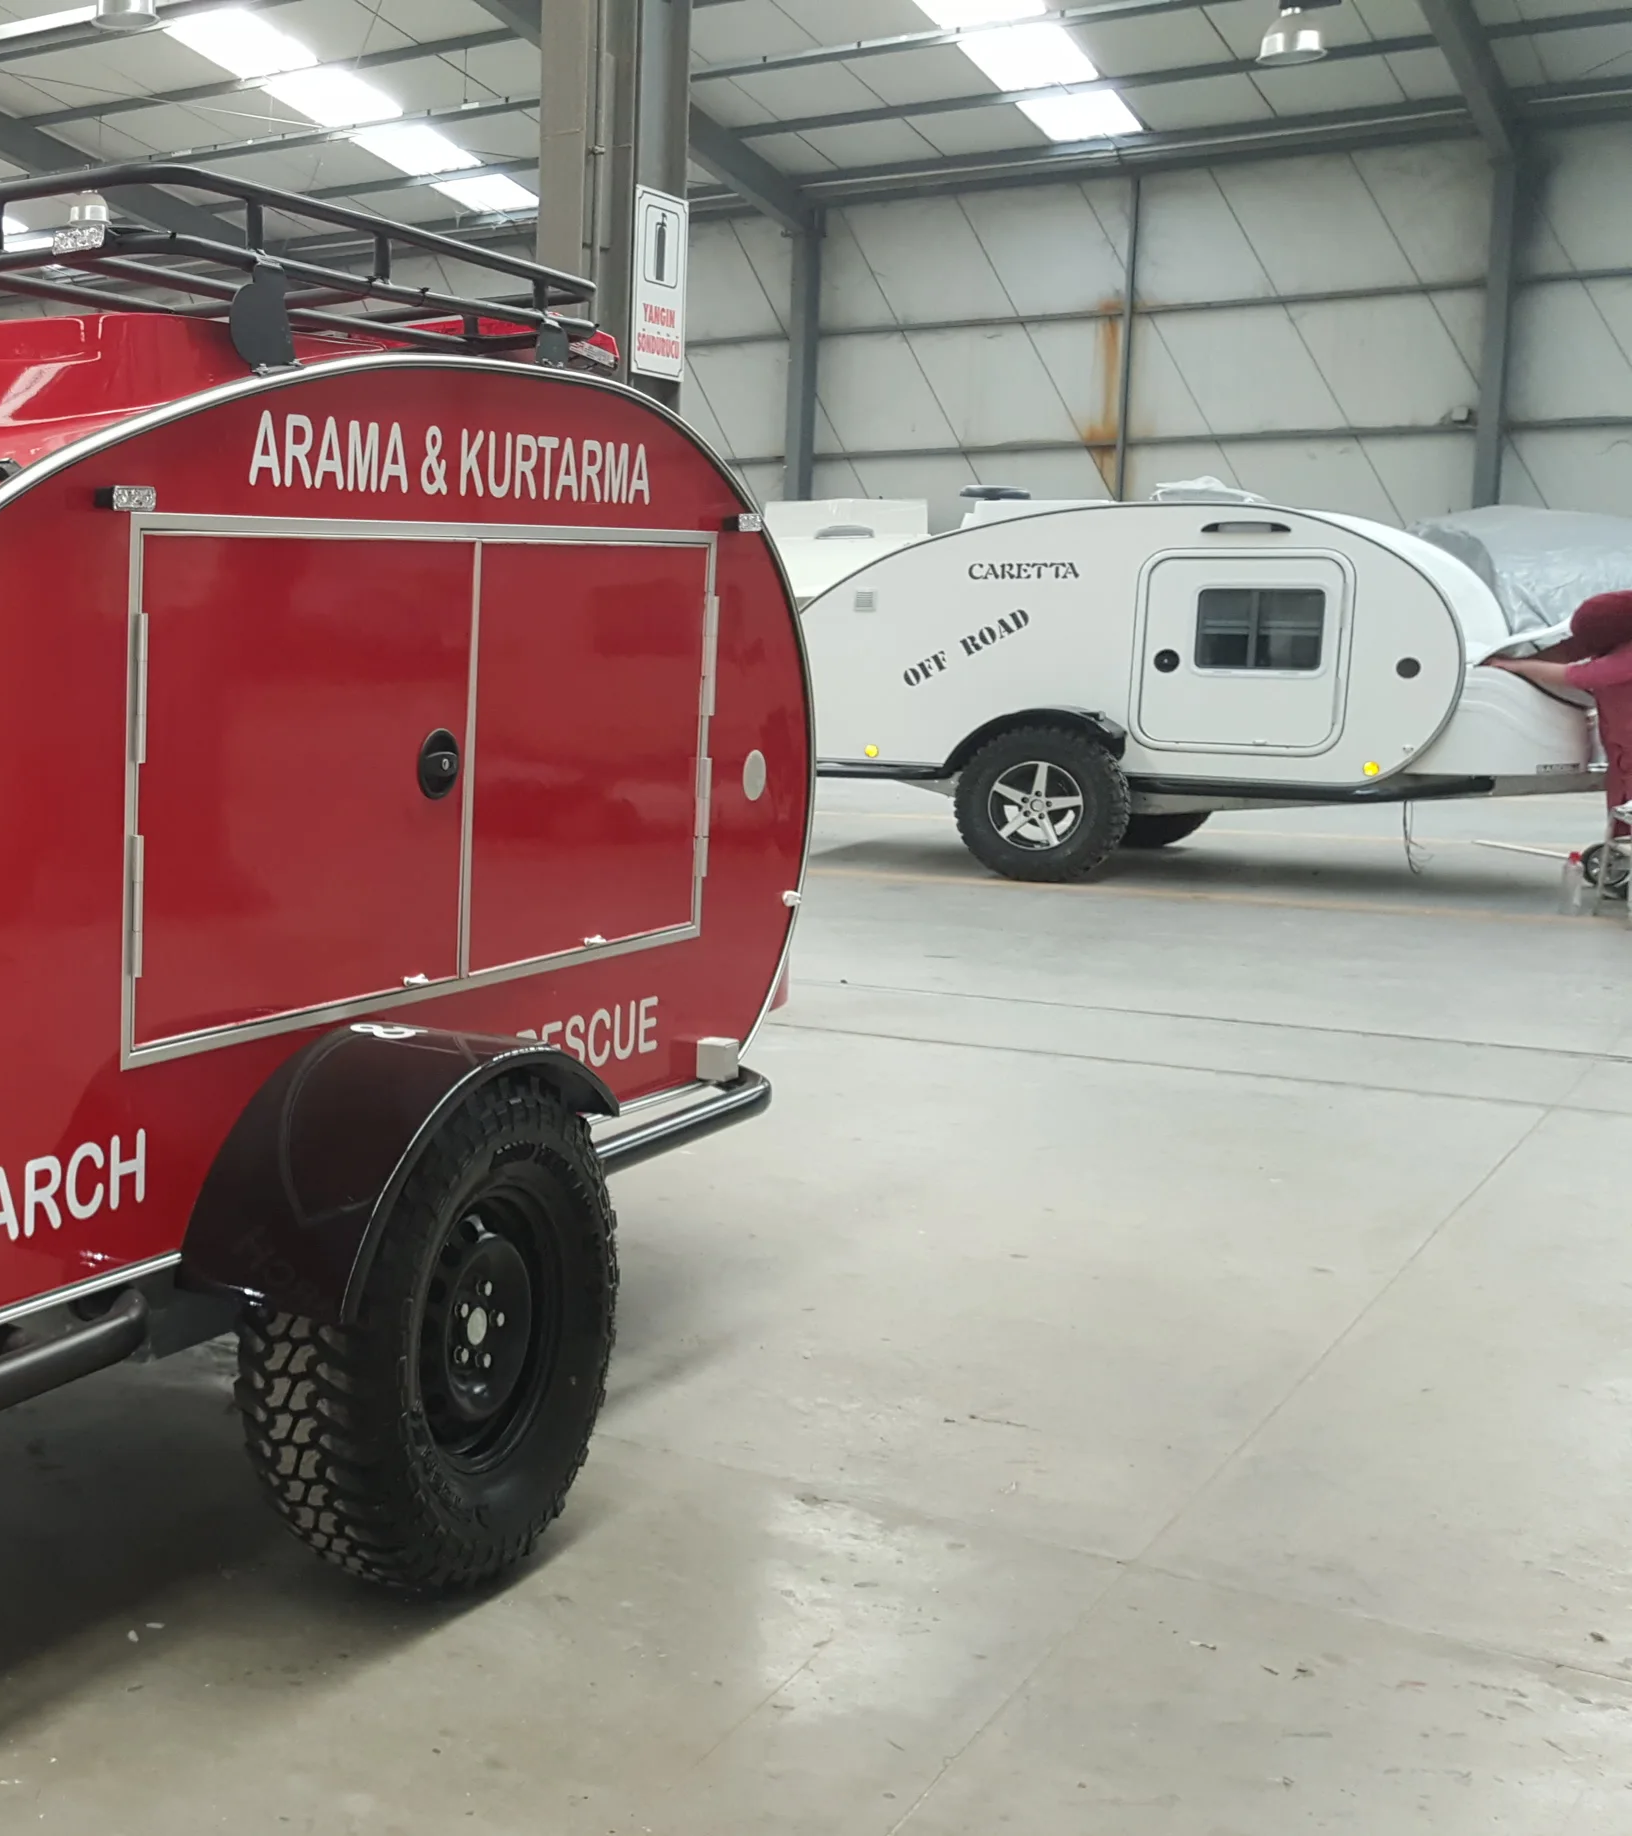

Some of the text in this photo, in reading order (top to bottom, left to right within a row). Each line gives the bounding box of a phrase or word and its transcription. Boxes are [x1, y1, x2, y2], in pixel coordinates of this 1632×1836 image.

[642, 302, 676, 329] YANGIN
[637, 328, 680, 360] SÖNDÜRÜCÜ
[249, 409, 651, 506] ARAMA & KURTARMA
[968, 562, 1080, 580] CARETTA
[903, 609, 1030, 687] OFF ROAD
[516, 995, 659, 1067] ESCUE
